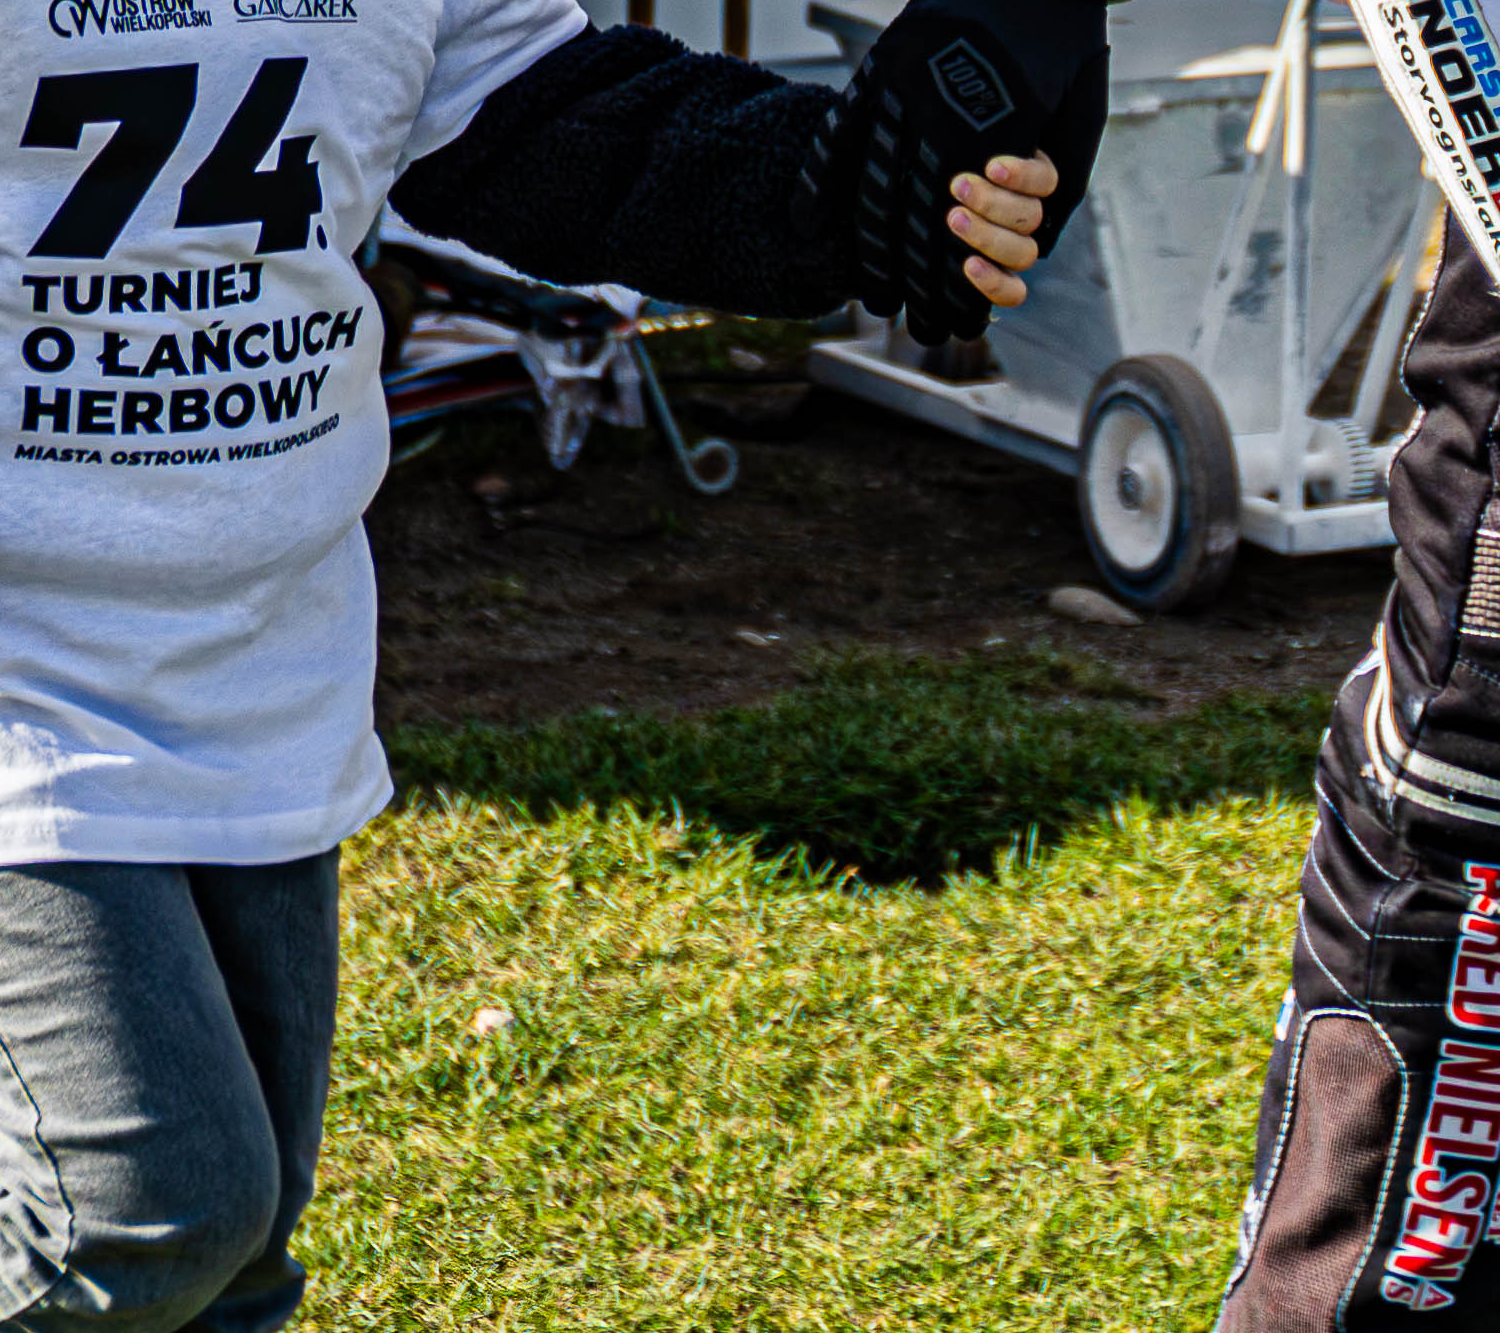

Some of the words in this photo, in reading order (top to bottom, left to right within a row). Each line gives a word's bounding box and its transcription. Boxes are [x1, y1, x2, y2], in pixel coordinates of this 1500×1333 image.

[110, 10, 213, 35] WIELKOPOLSKI
[19, 55, 329, 260] 74.
[21, 261, 264, 315] TURNIEJ
[21, 326, 76, 374] O
[96, 306, 364, 378] ŁAŃCUCH
[20, 363, 331, 435] HERBOWY
[13, 443, 103, 465] MIASTA
[110, 446, 221, 467] OSTROWA
[227, 412, 340, 462] WIELKOPOLSKIEGO
